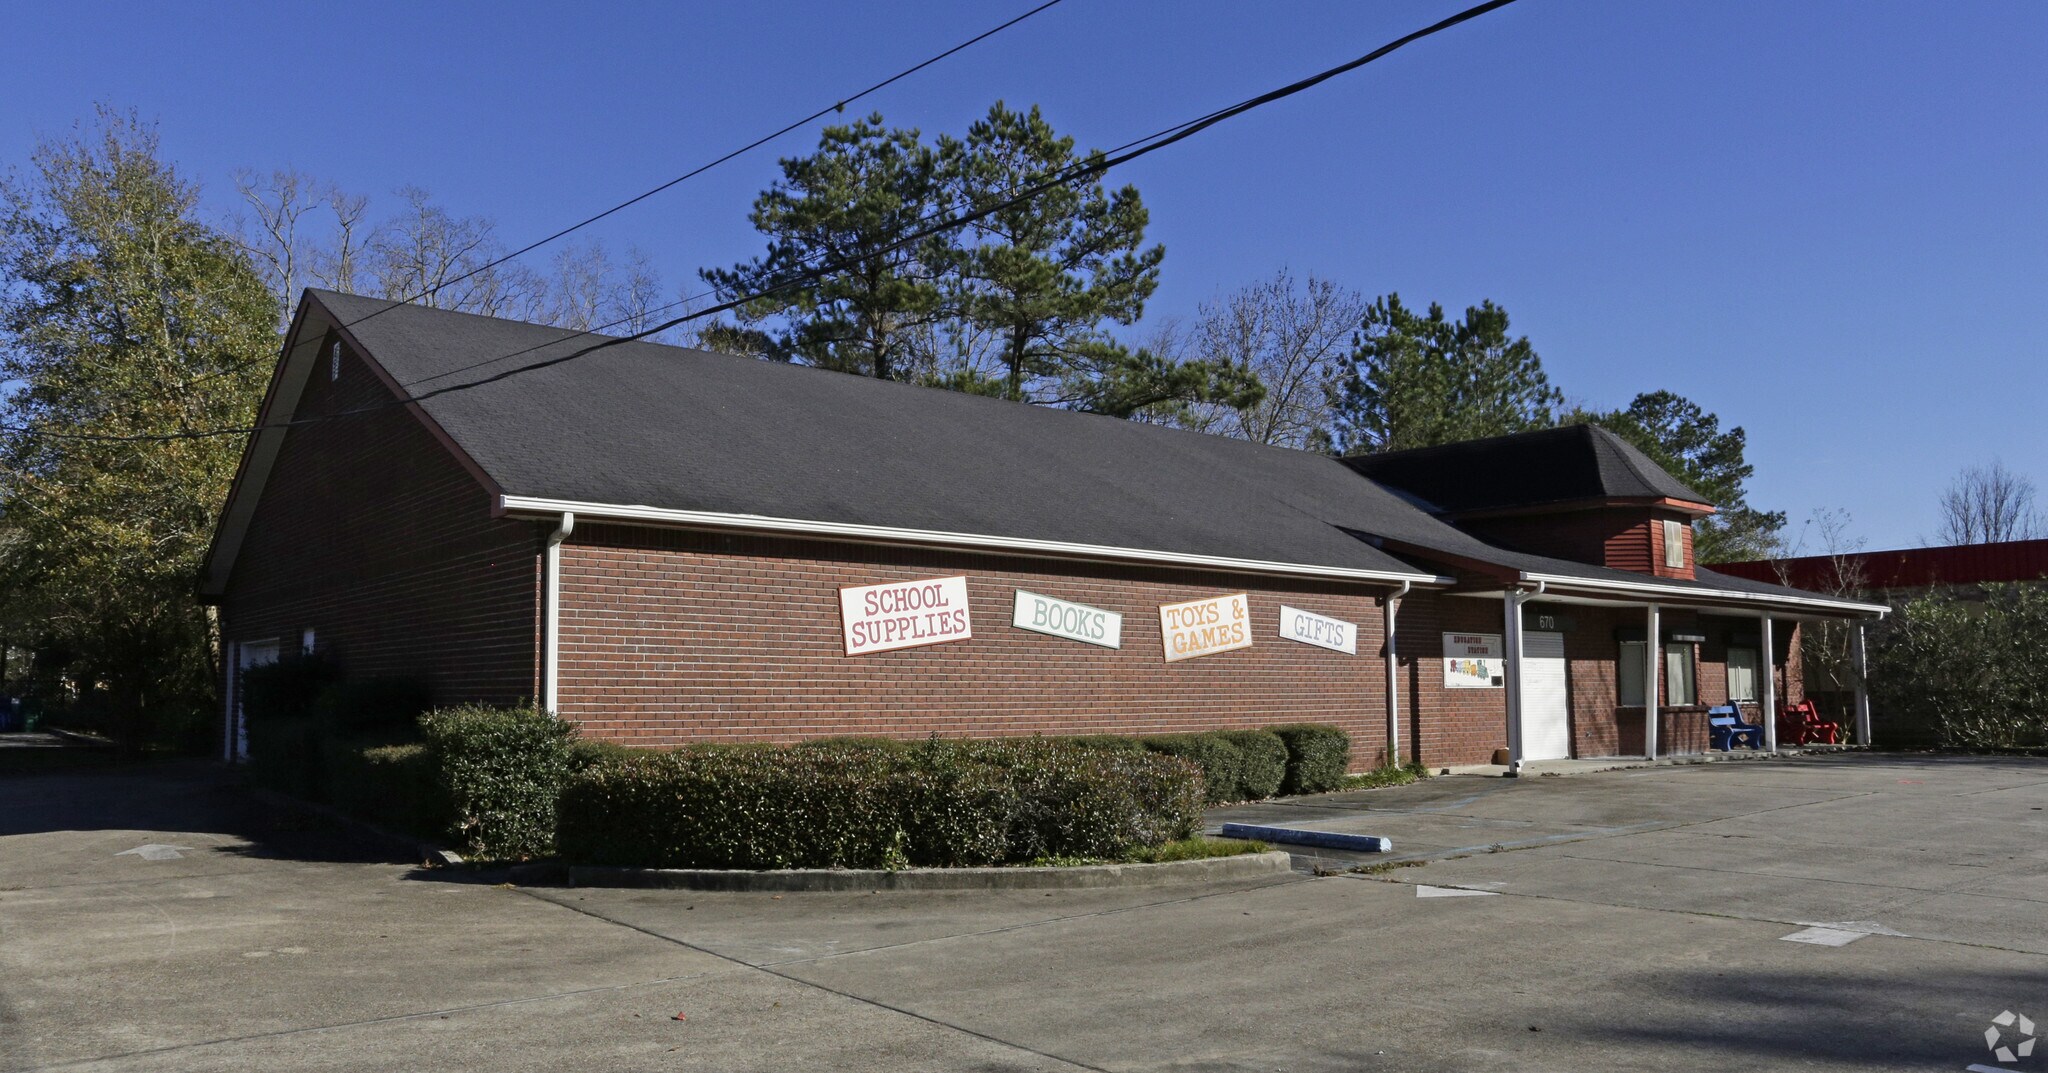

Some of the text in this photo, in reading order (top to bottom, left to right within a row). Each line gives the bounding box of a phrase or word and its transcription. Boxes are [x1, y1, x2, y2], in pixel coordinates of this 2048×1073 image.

[864, 584, 949, 616] SCHOOL
[1166, 598, 1244, 630] TOYS &
[851, 608, 967, 648] SUPPLIES
[1032, 598, 1106, 640] BOOKS
[1294, 614, 1344, 647] GIFTS
[1539, 615, 1555, 629] 670
[1172, 622, 1245, 654] GAMES
